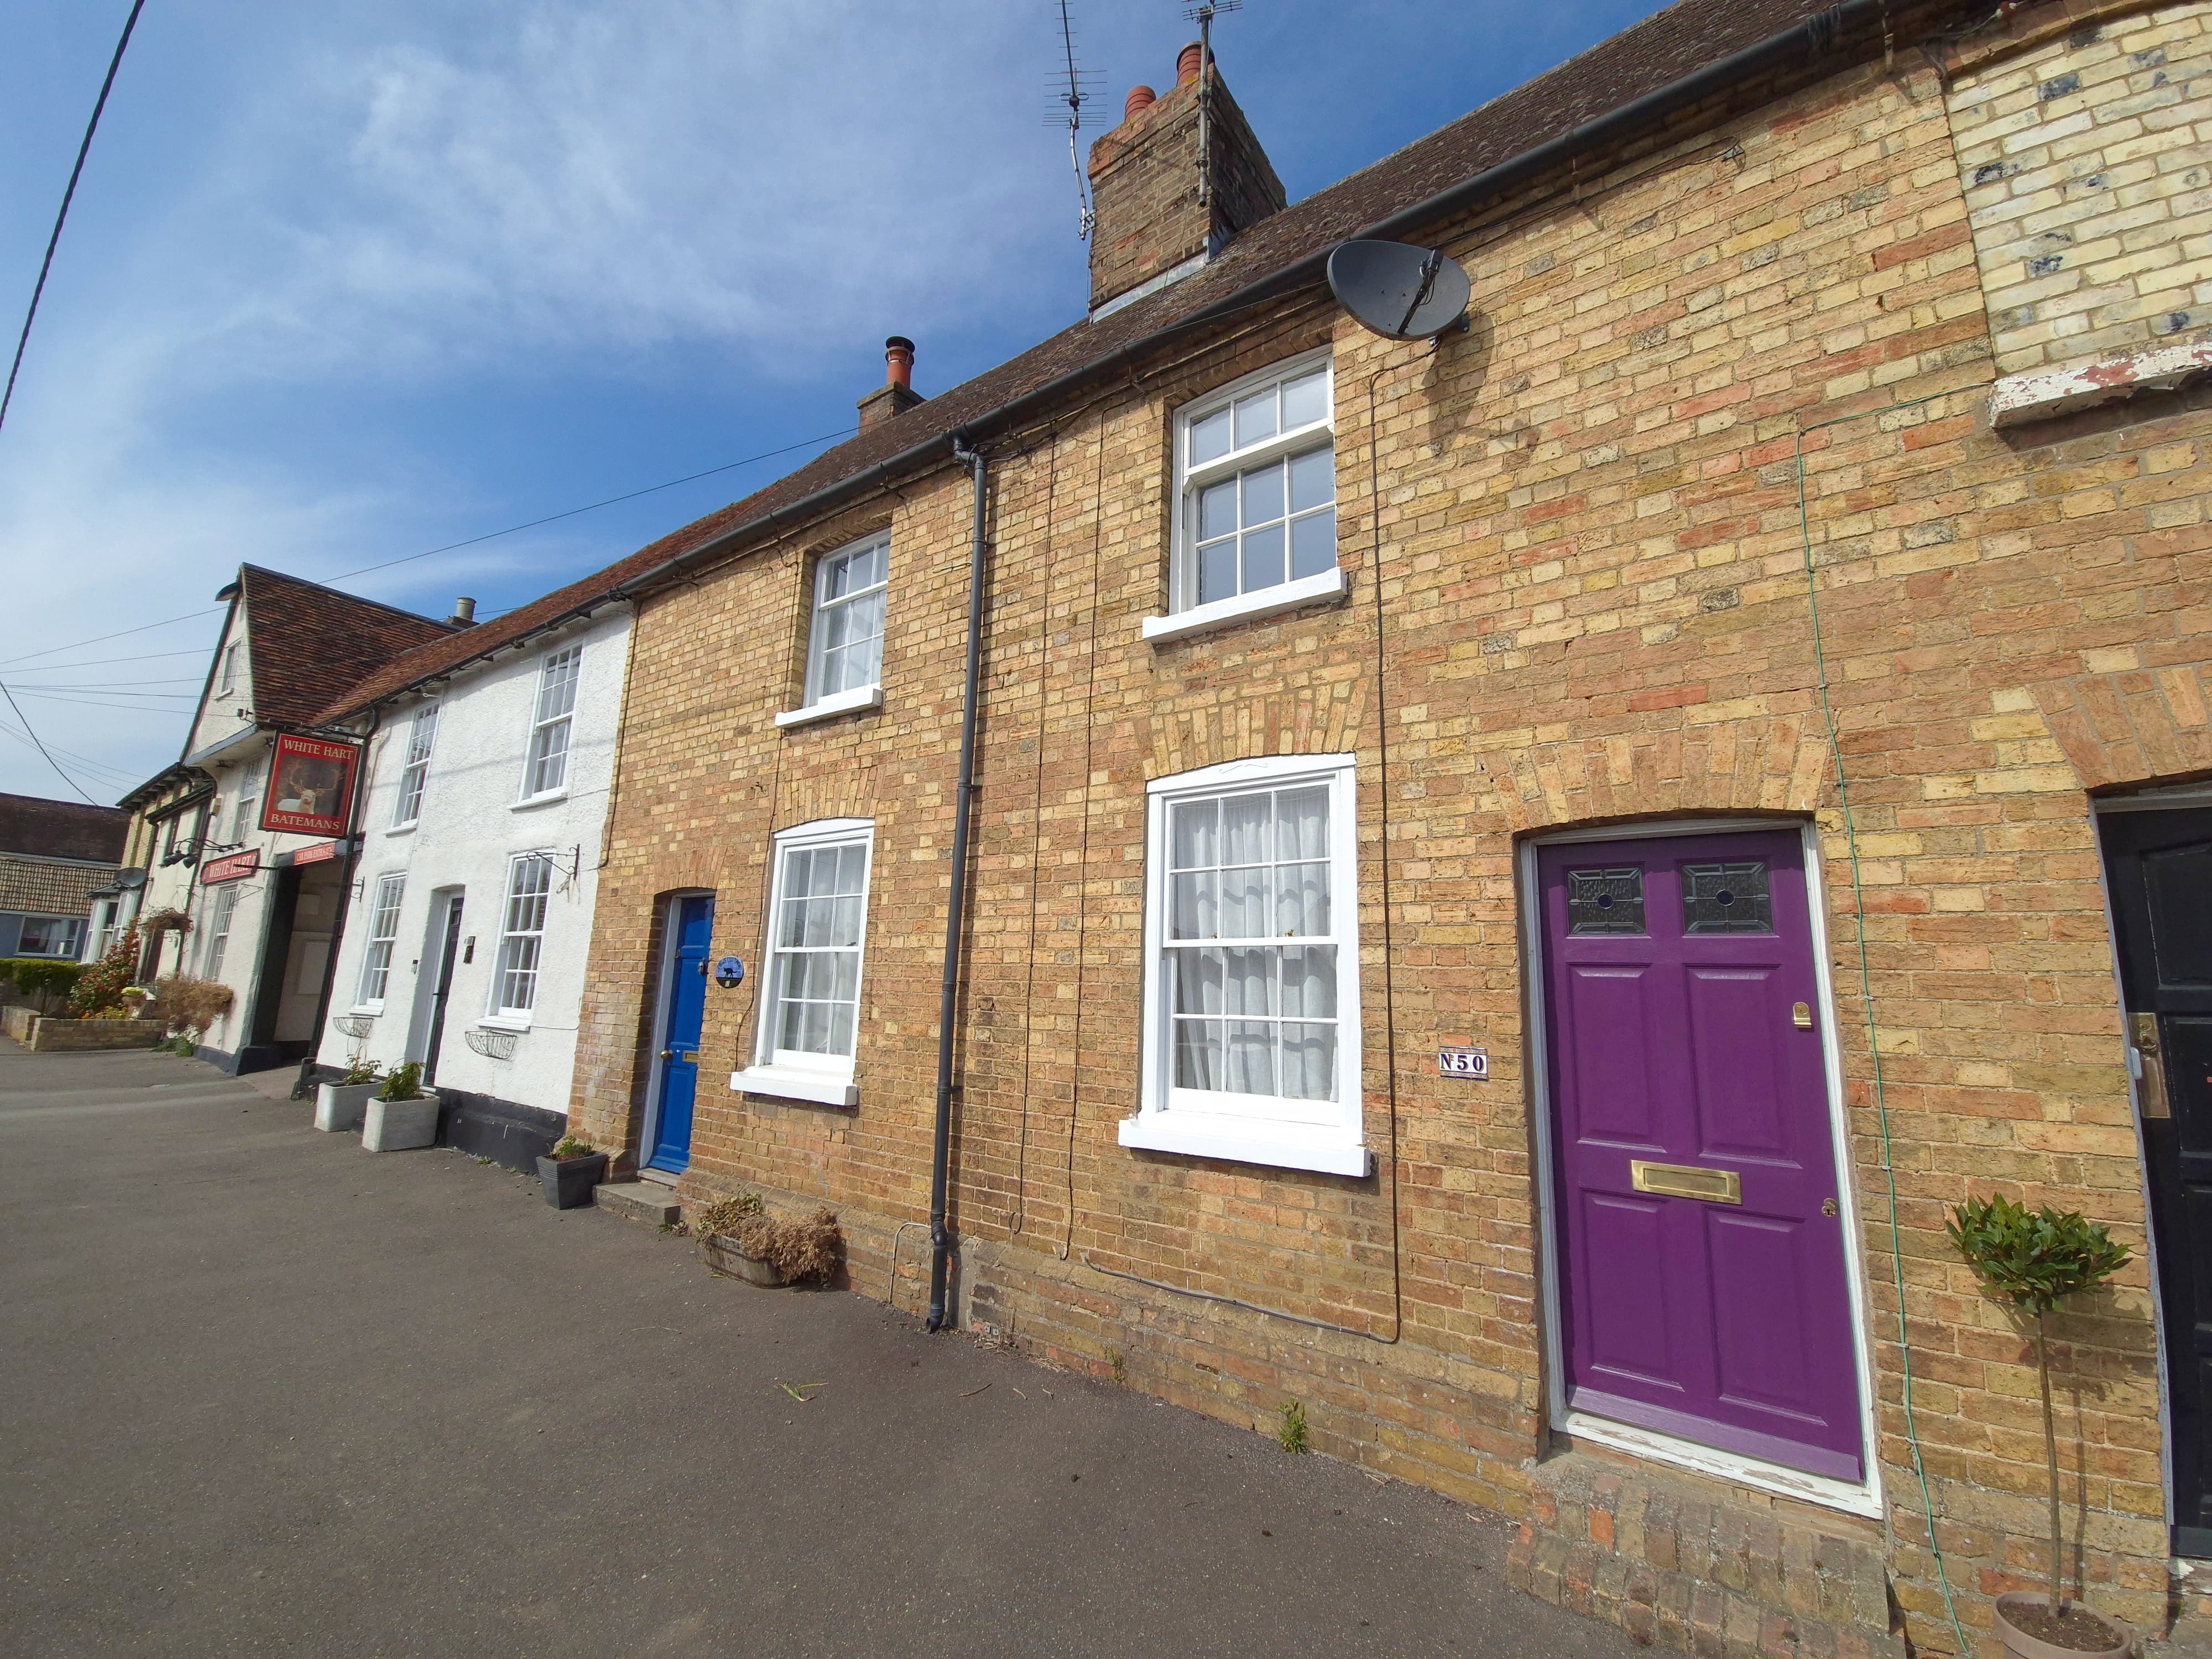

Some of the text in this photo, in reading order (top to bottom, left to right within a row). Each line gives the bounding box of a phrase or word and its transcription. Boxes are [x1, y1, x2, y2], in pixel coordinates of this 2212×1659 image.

[284, 739, 354, 760] WHITE HART
[270, 813, 340, 830] BATEMANS
[210, 855, 252, 878] WHITE HART
[1457, 1055, 1485, 1072] 50
